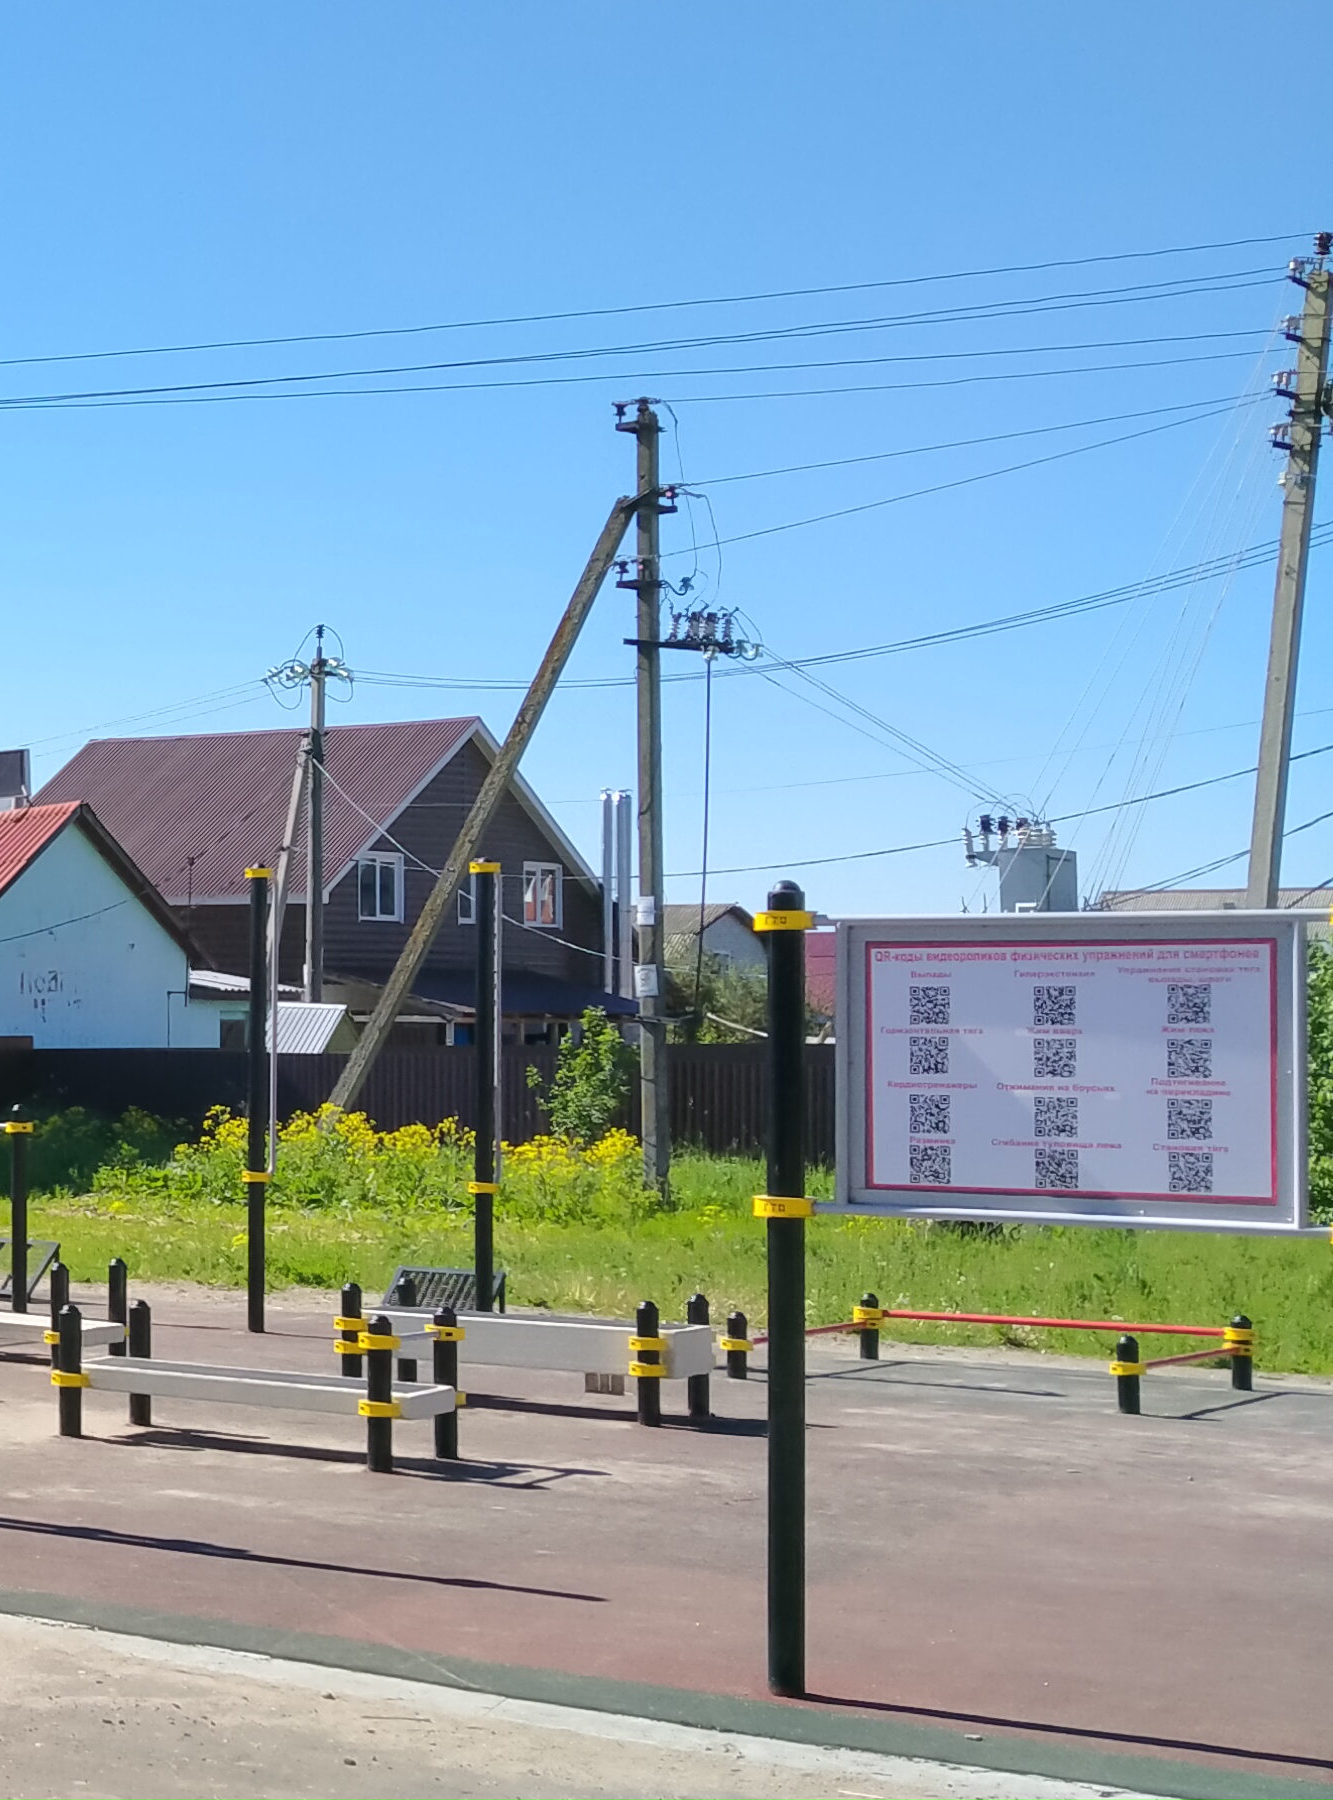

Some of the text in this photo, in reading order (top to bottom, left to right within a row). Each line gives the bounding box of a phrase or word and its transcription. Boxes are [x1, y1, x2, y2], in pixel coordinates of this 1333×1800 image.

[1010, 950, 1079, 962] физических
[1083, 949, 1154, 962] упражнений
[1157, 950, 1180, 961] для
